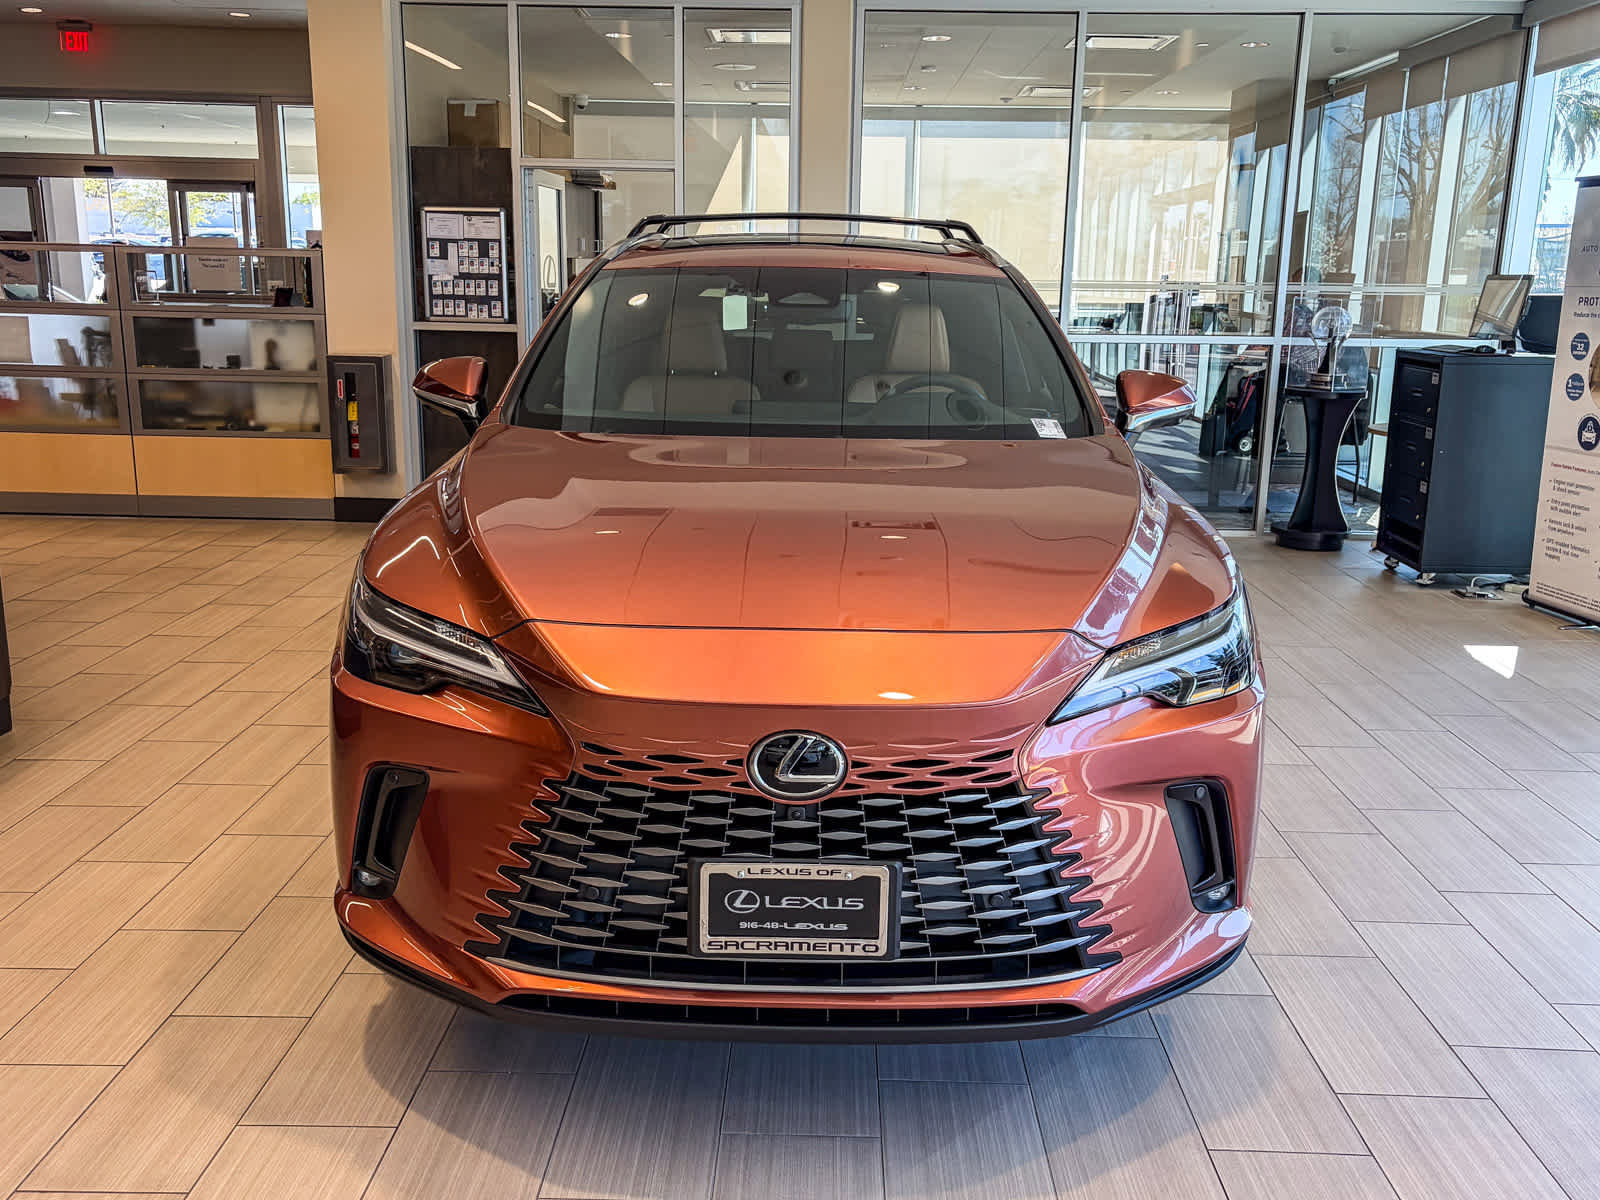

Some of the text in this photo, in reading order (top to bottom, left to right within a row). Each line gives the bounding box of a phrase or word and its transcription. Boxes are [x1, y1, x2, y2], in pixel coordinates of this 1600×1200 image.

[65, 32, 89, 52] EXIT
[747, 867, 842, 876] LEXUS OF
[764, 896, 864, 910] LEXUS
[707, 940, 879, 953] SACRAMENTO
